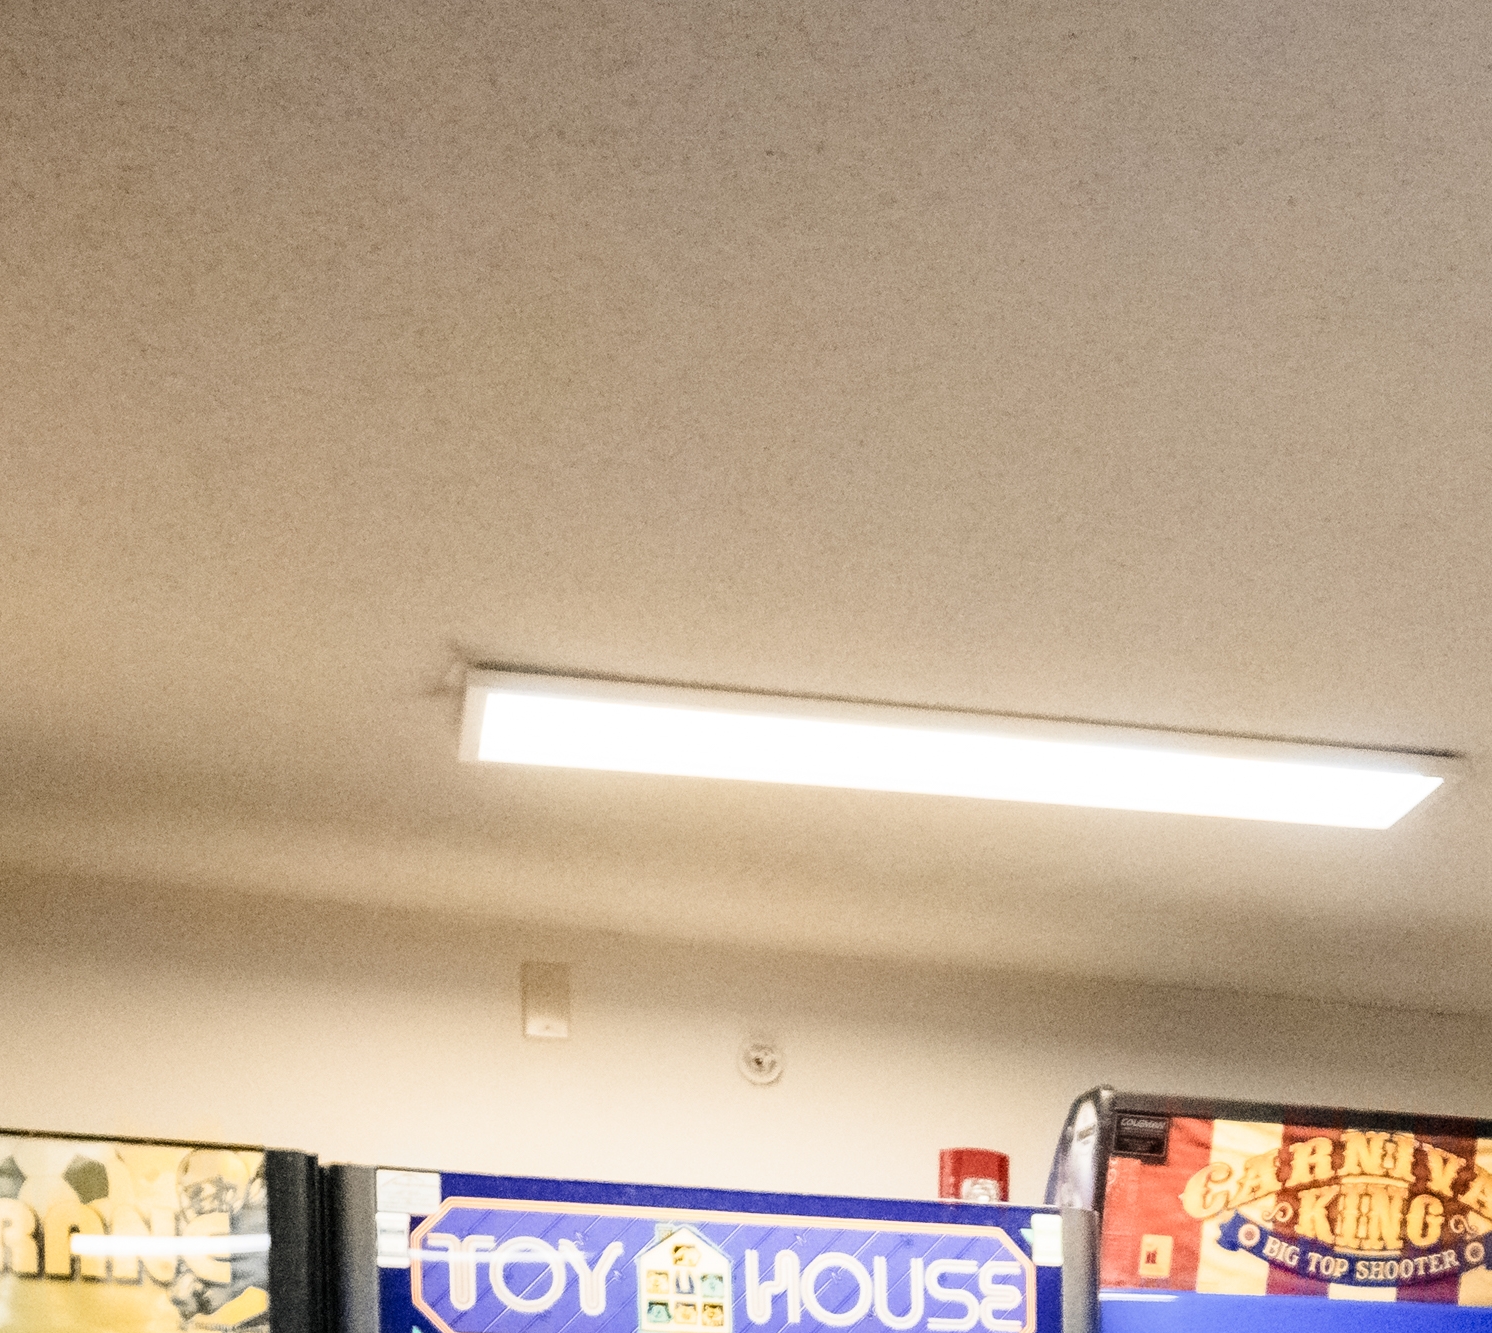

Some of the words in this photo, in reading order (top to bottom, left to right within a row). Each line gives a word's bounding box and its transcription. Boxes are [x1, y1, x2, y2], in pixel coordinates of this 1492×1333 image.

[1294, 1182, 1445, 1253] KING
[426, 1233, 624, 1317] TOY
[744, 1248, 1023, 1332] HOUSE
[1263, 1236, 1301, 1268] BIG
[1308, 1250, 1350, 1279] TOP
[1355, 1248, 1460, 1282] SHOOTER
